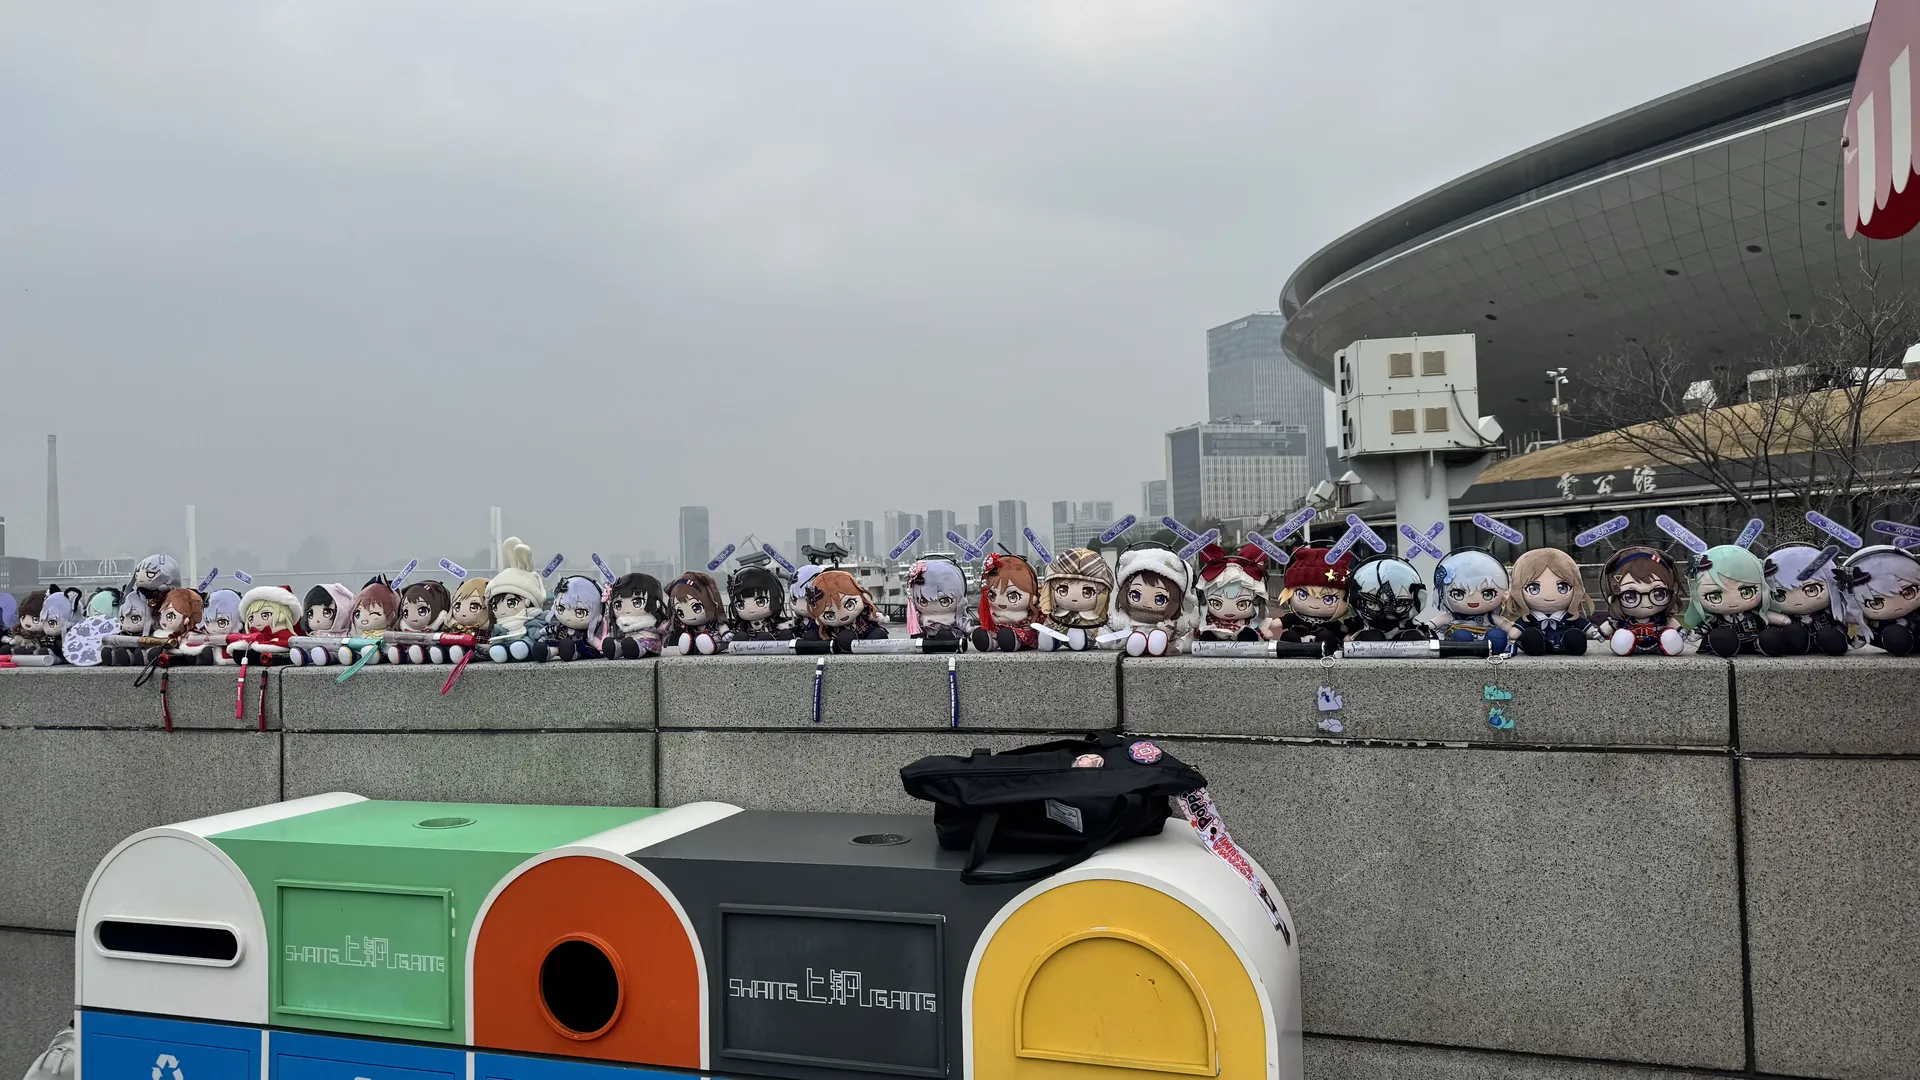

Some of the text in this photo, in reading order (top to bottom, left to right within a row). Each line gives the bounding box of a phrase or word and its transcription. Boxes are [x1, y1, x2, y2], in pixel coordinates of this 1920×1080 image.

[285, 945, 339, 964] SHANG
[729, 978, 798, 1001] SHANG
[869, 989, 936, 1012] GANG
